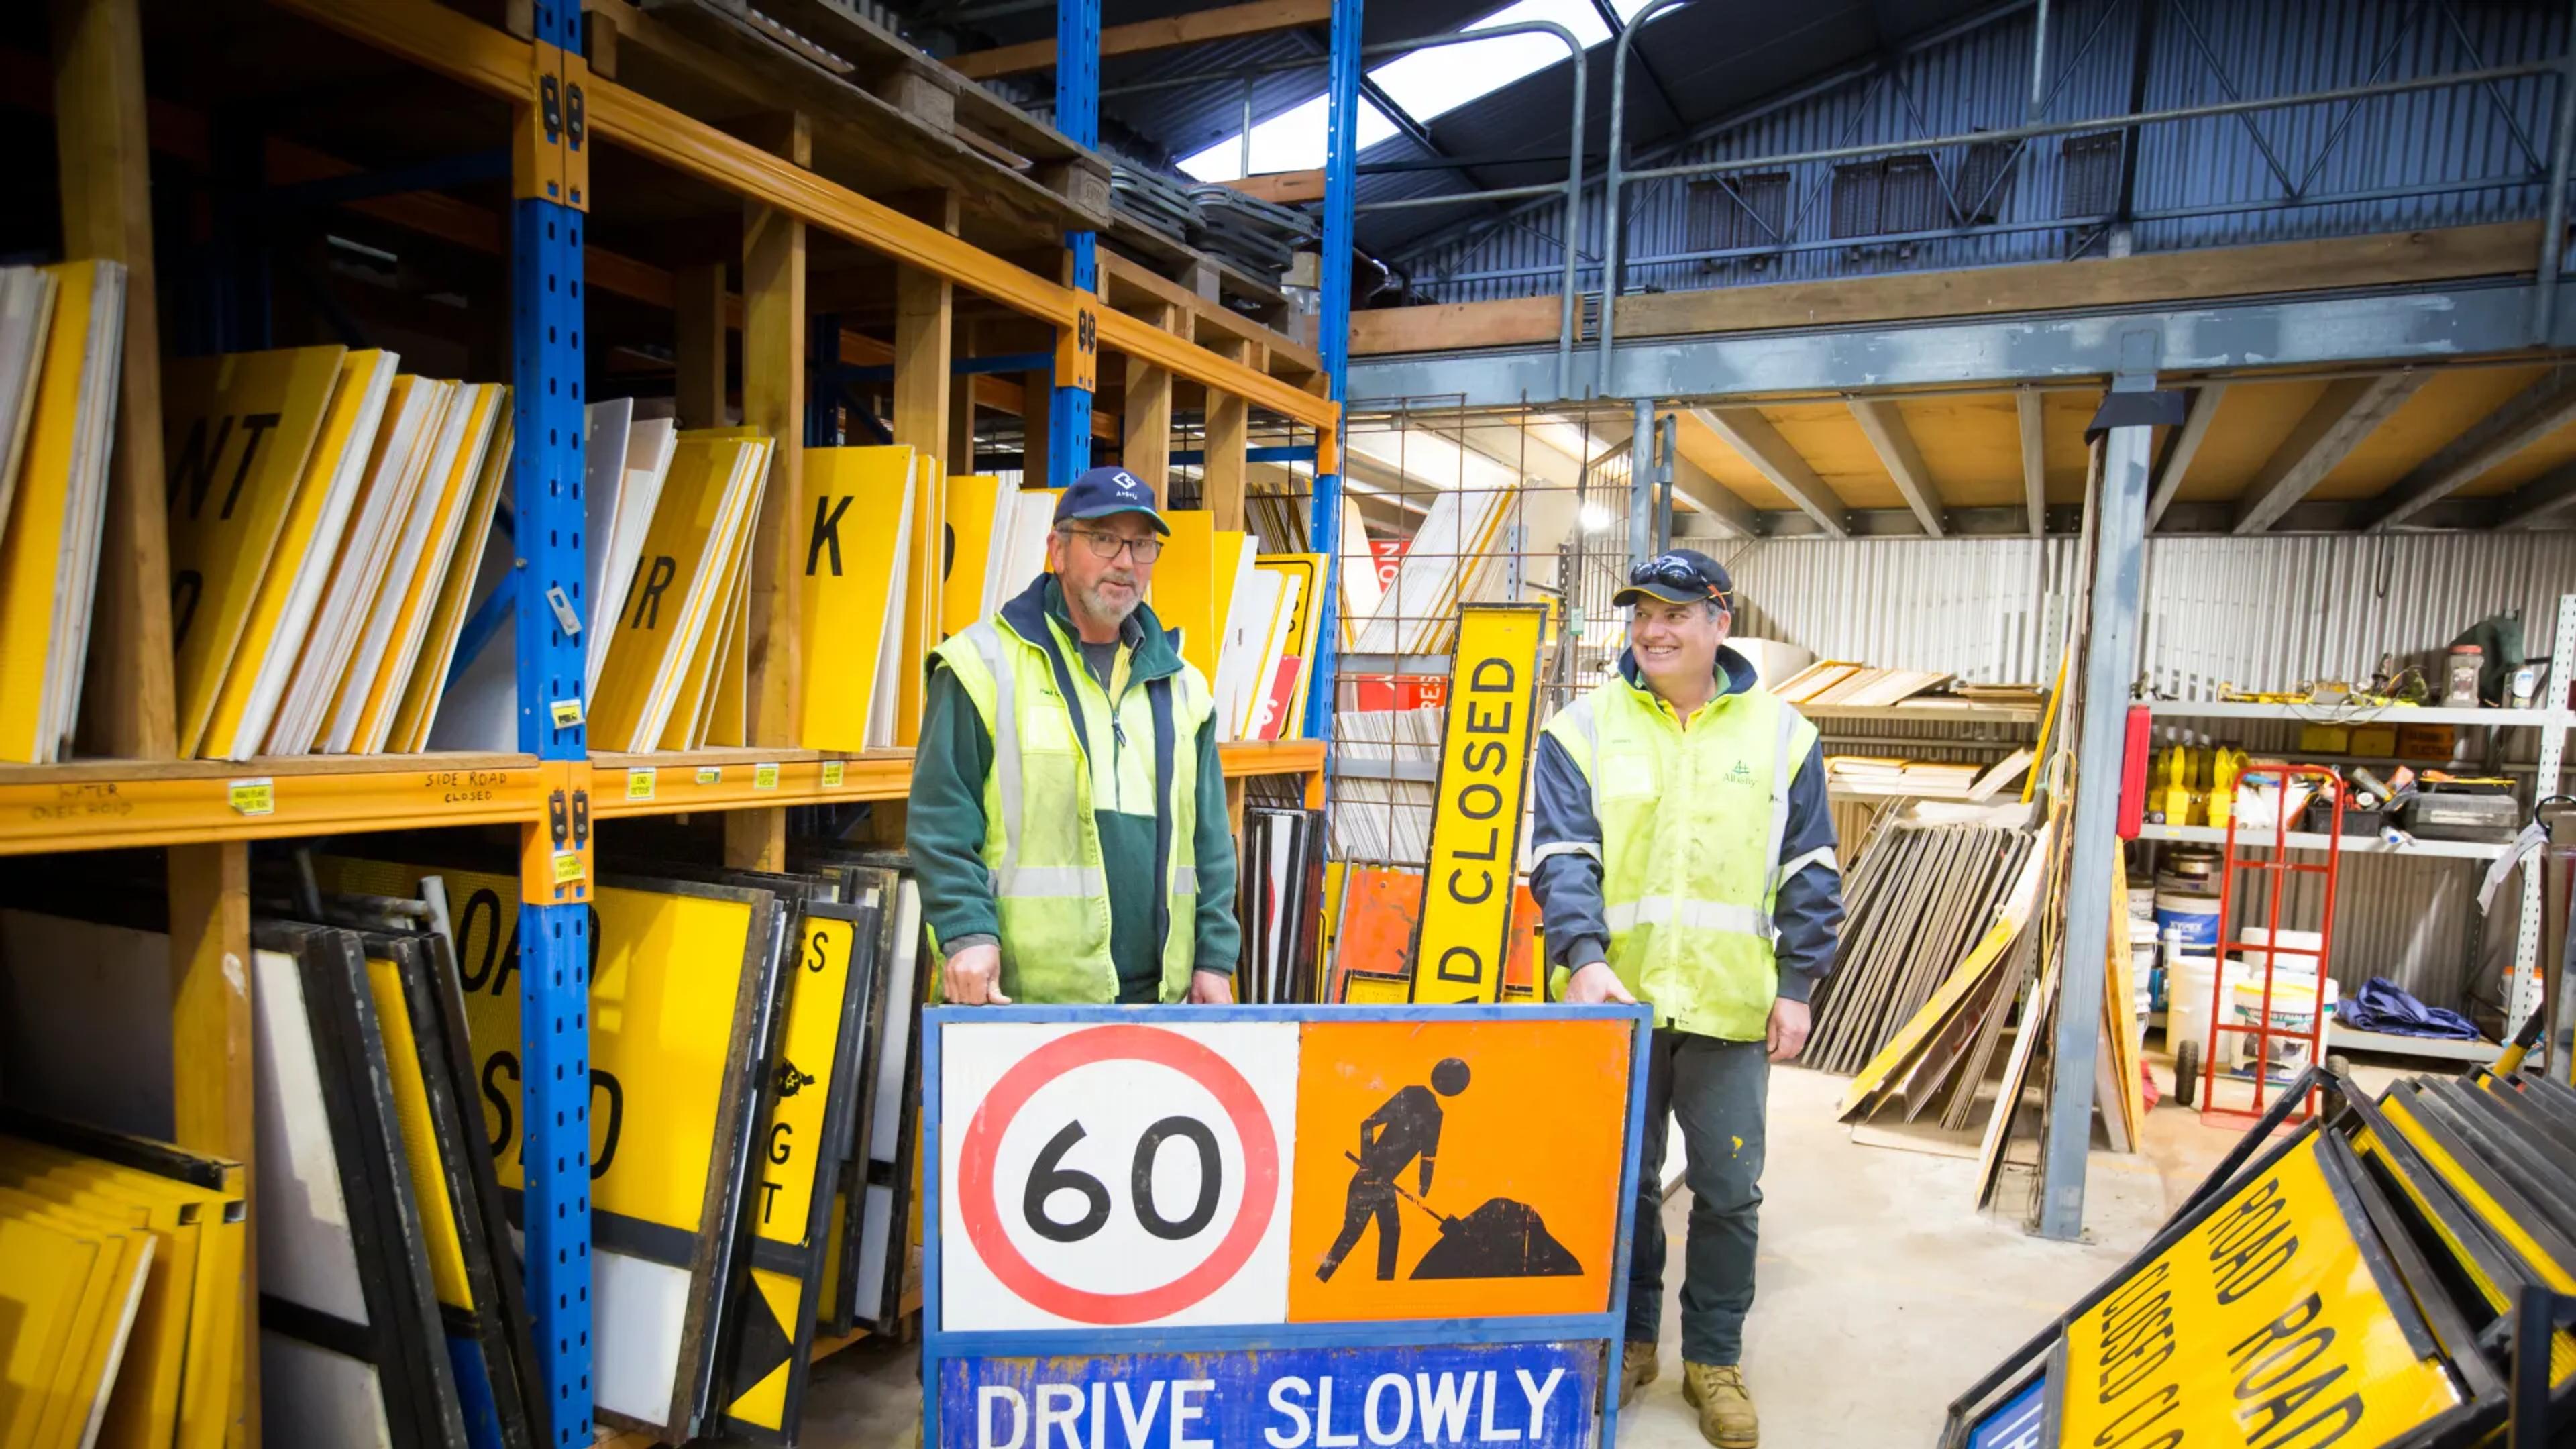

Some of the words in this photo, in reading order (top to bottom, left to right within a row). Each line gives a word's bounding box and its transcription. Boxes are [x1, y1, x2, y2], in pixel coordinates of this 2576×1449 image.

[425, 773, 458, 787] SIDE
[470, 771, 507, 786] ROAD
[445, 790, 492, 803] CLOSED
[1448, 657, 1516, 905] CLOSED
[1022, 1114, 1222, 1243] 60
[2208, 1177, 2300, 1305] ROAD
[2098, 1261, 2176, 1405] CLOSED
[2226, 1291, 2364, 1449] ROAD
[977, 1378, 1215, 1449] DRIVE
[1264, 1367, 1566, 1449] SLOWLY
